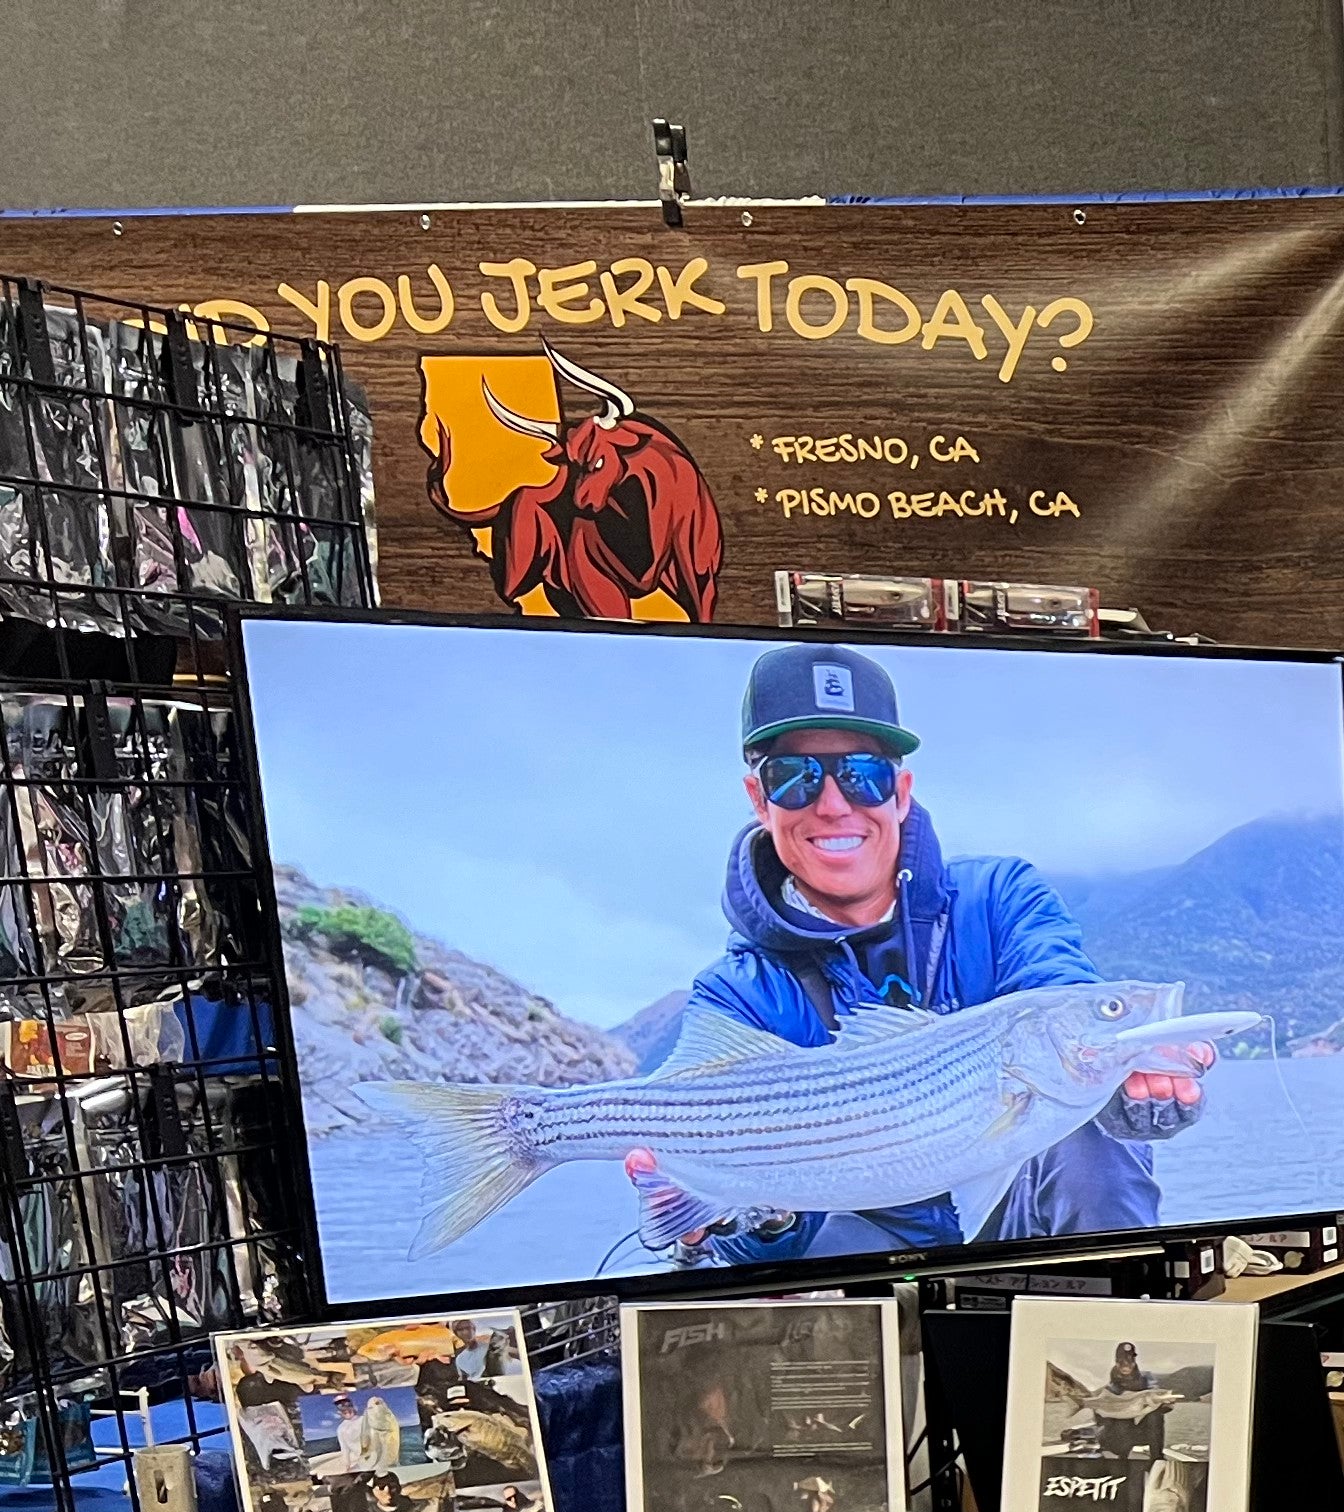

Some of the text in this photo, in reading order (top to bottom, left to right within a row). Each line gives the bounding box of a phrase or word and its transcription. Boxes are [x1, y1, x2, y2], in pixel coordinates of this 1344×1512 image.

[277, 263, 455, 361] YOU
[479, 257, 726, 334] JERK
[737, 259, 1095, 383] TODAY?
[772, 434, 981, 470] FRESNO, CA
[775, 488, 1081, 524] PISMO BEACH, CA
